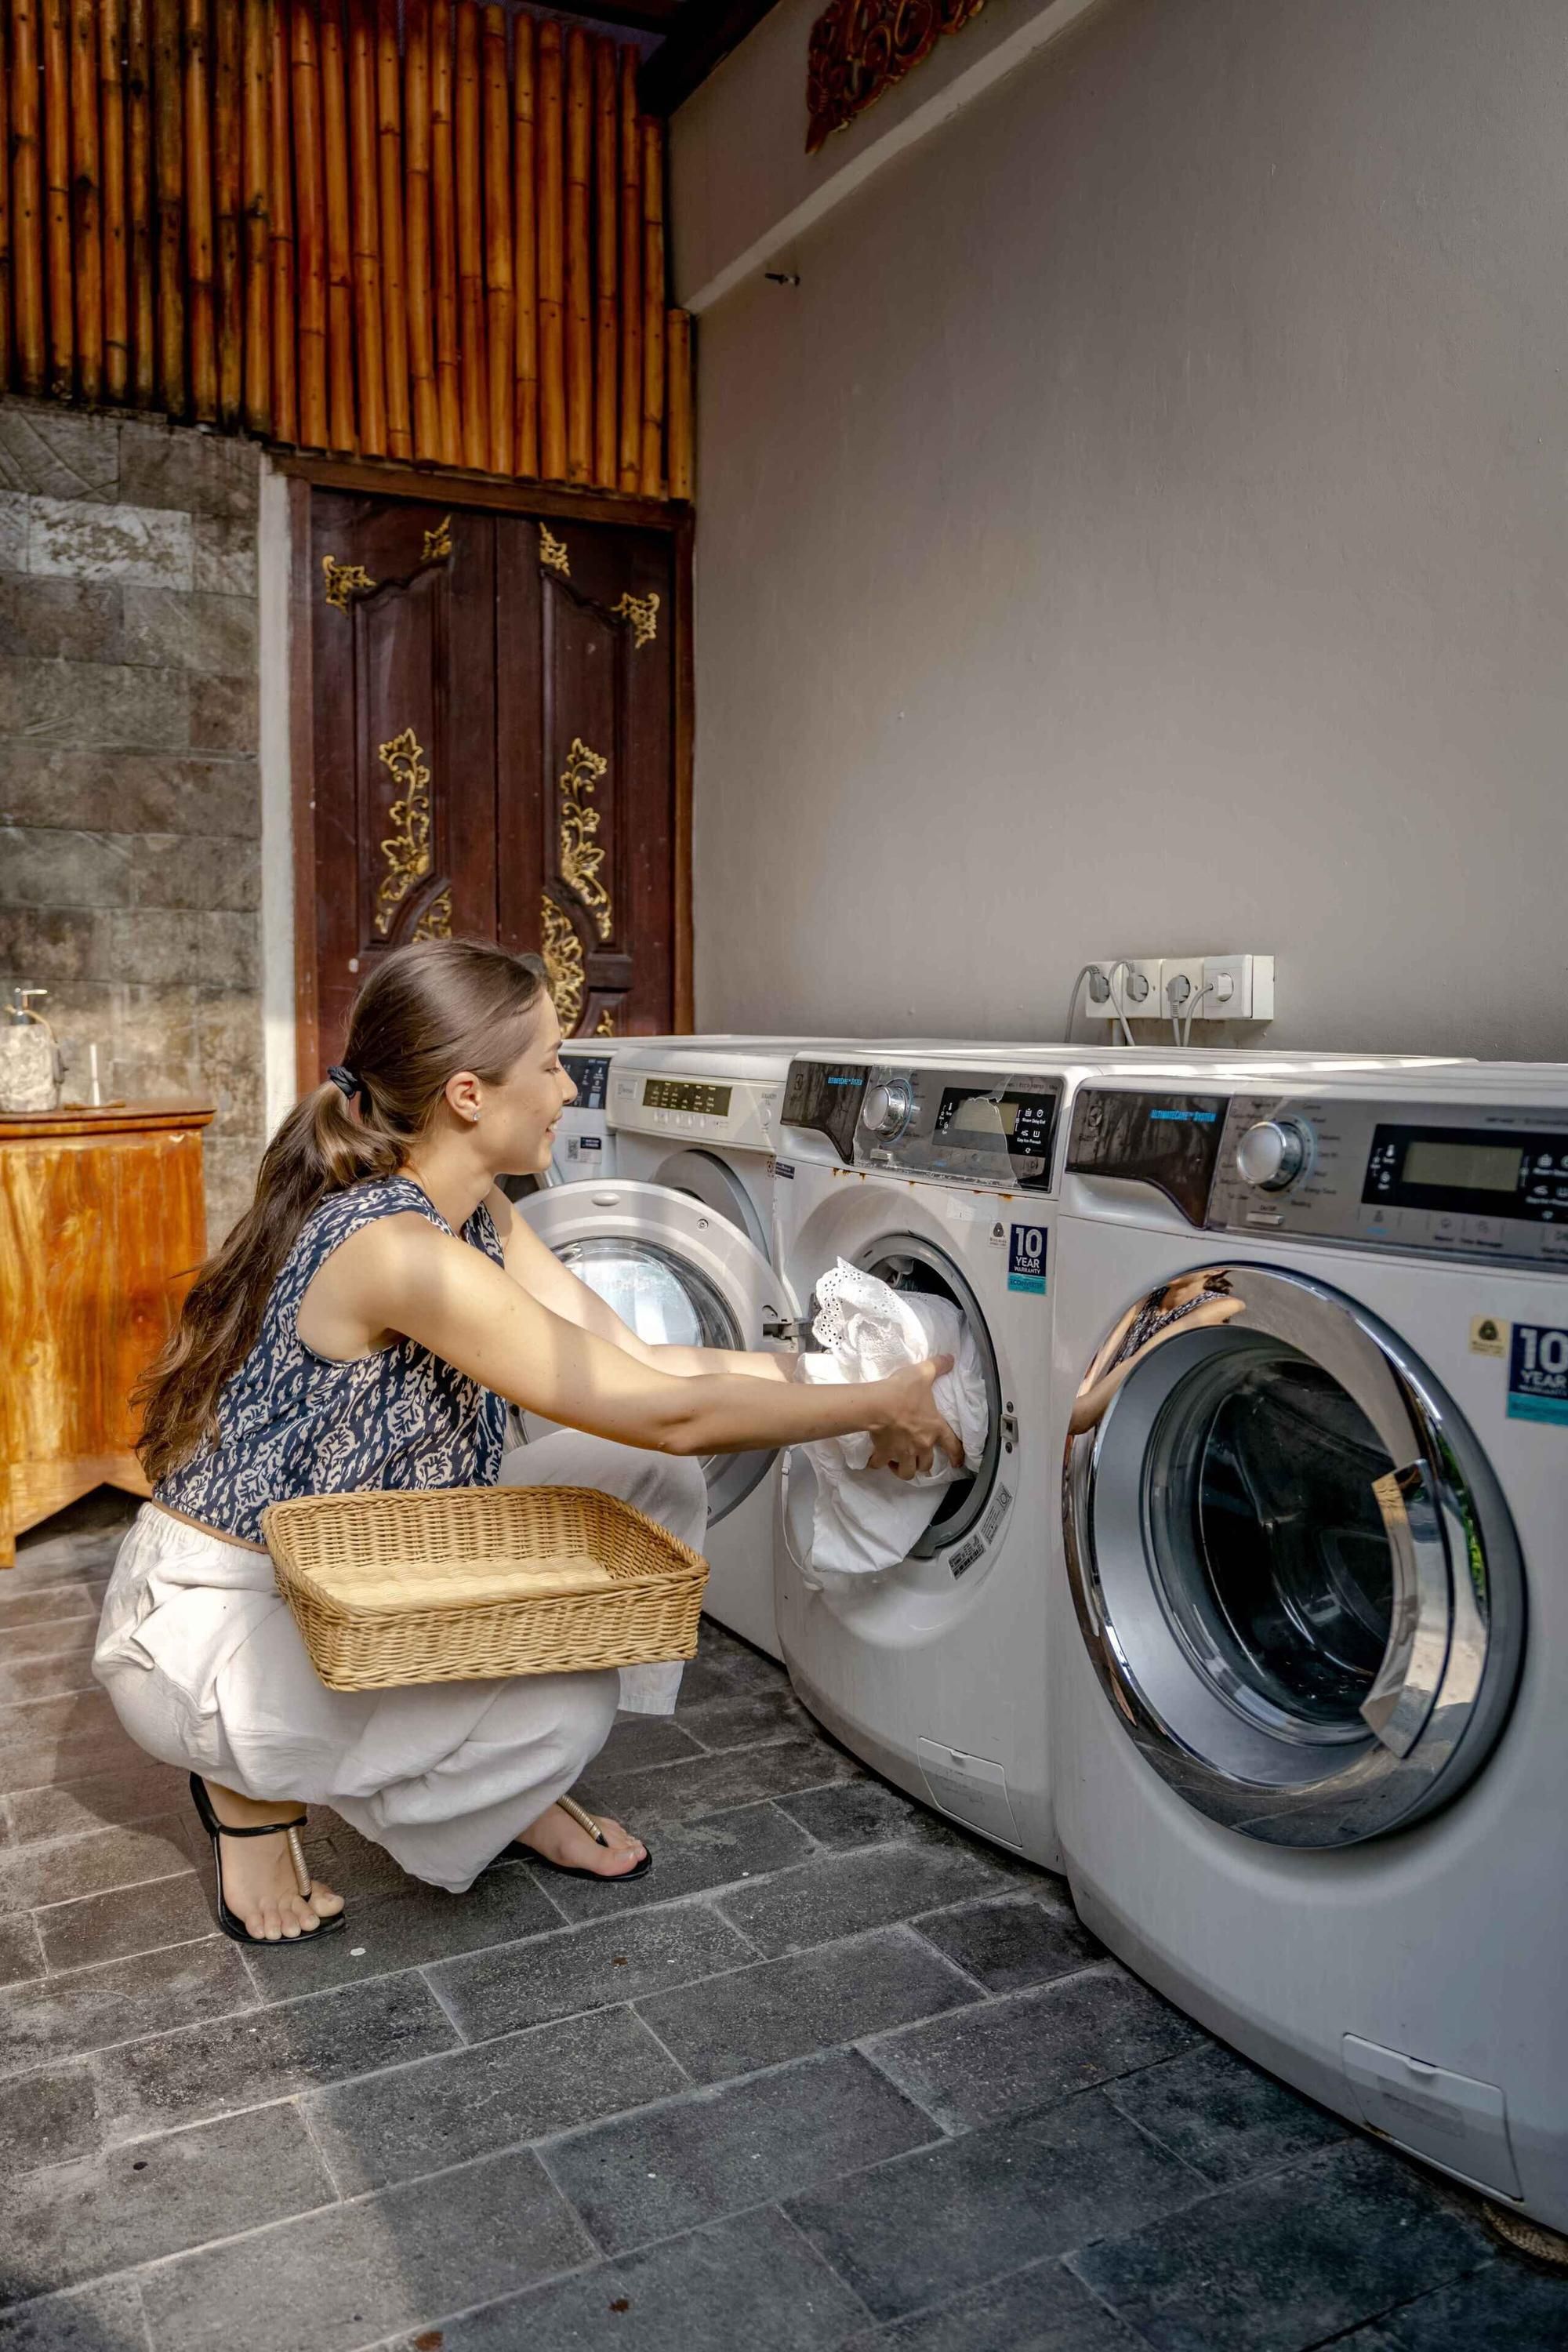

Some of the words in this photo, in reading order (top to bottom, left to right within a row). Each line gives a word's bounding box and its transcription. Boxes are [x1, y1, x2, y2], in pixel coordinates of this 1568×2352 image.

[1015, 1227, 1043, 1258] 10
[1014, 1265, 1041, 1276] WARRANTY
[1015, 1256, 1040, 1269] YEAR
[1519, 1327, 1568, 1374] 10
[1520, 1369, 1567, 1389] YEAR
